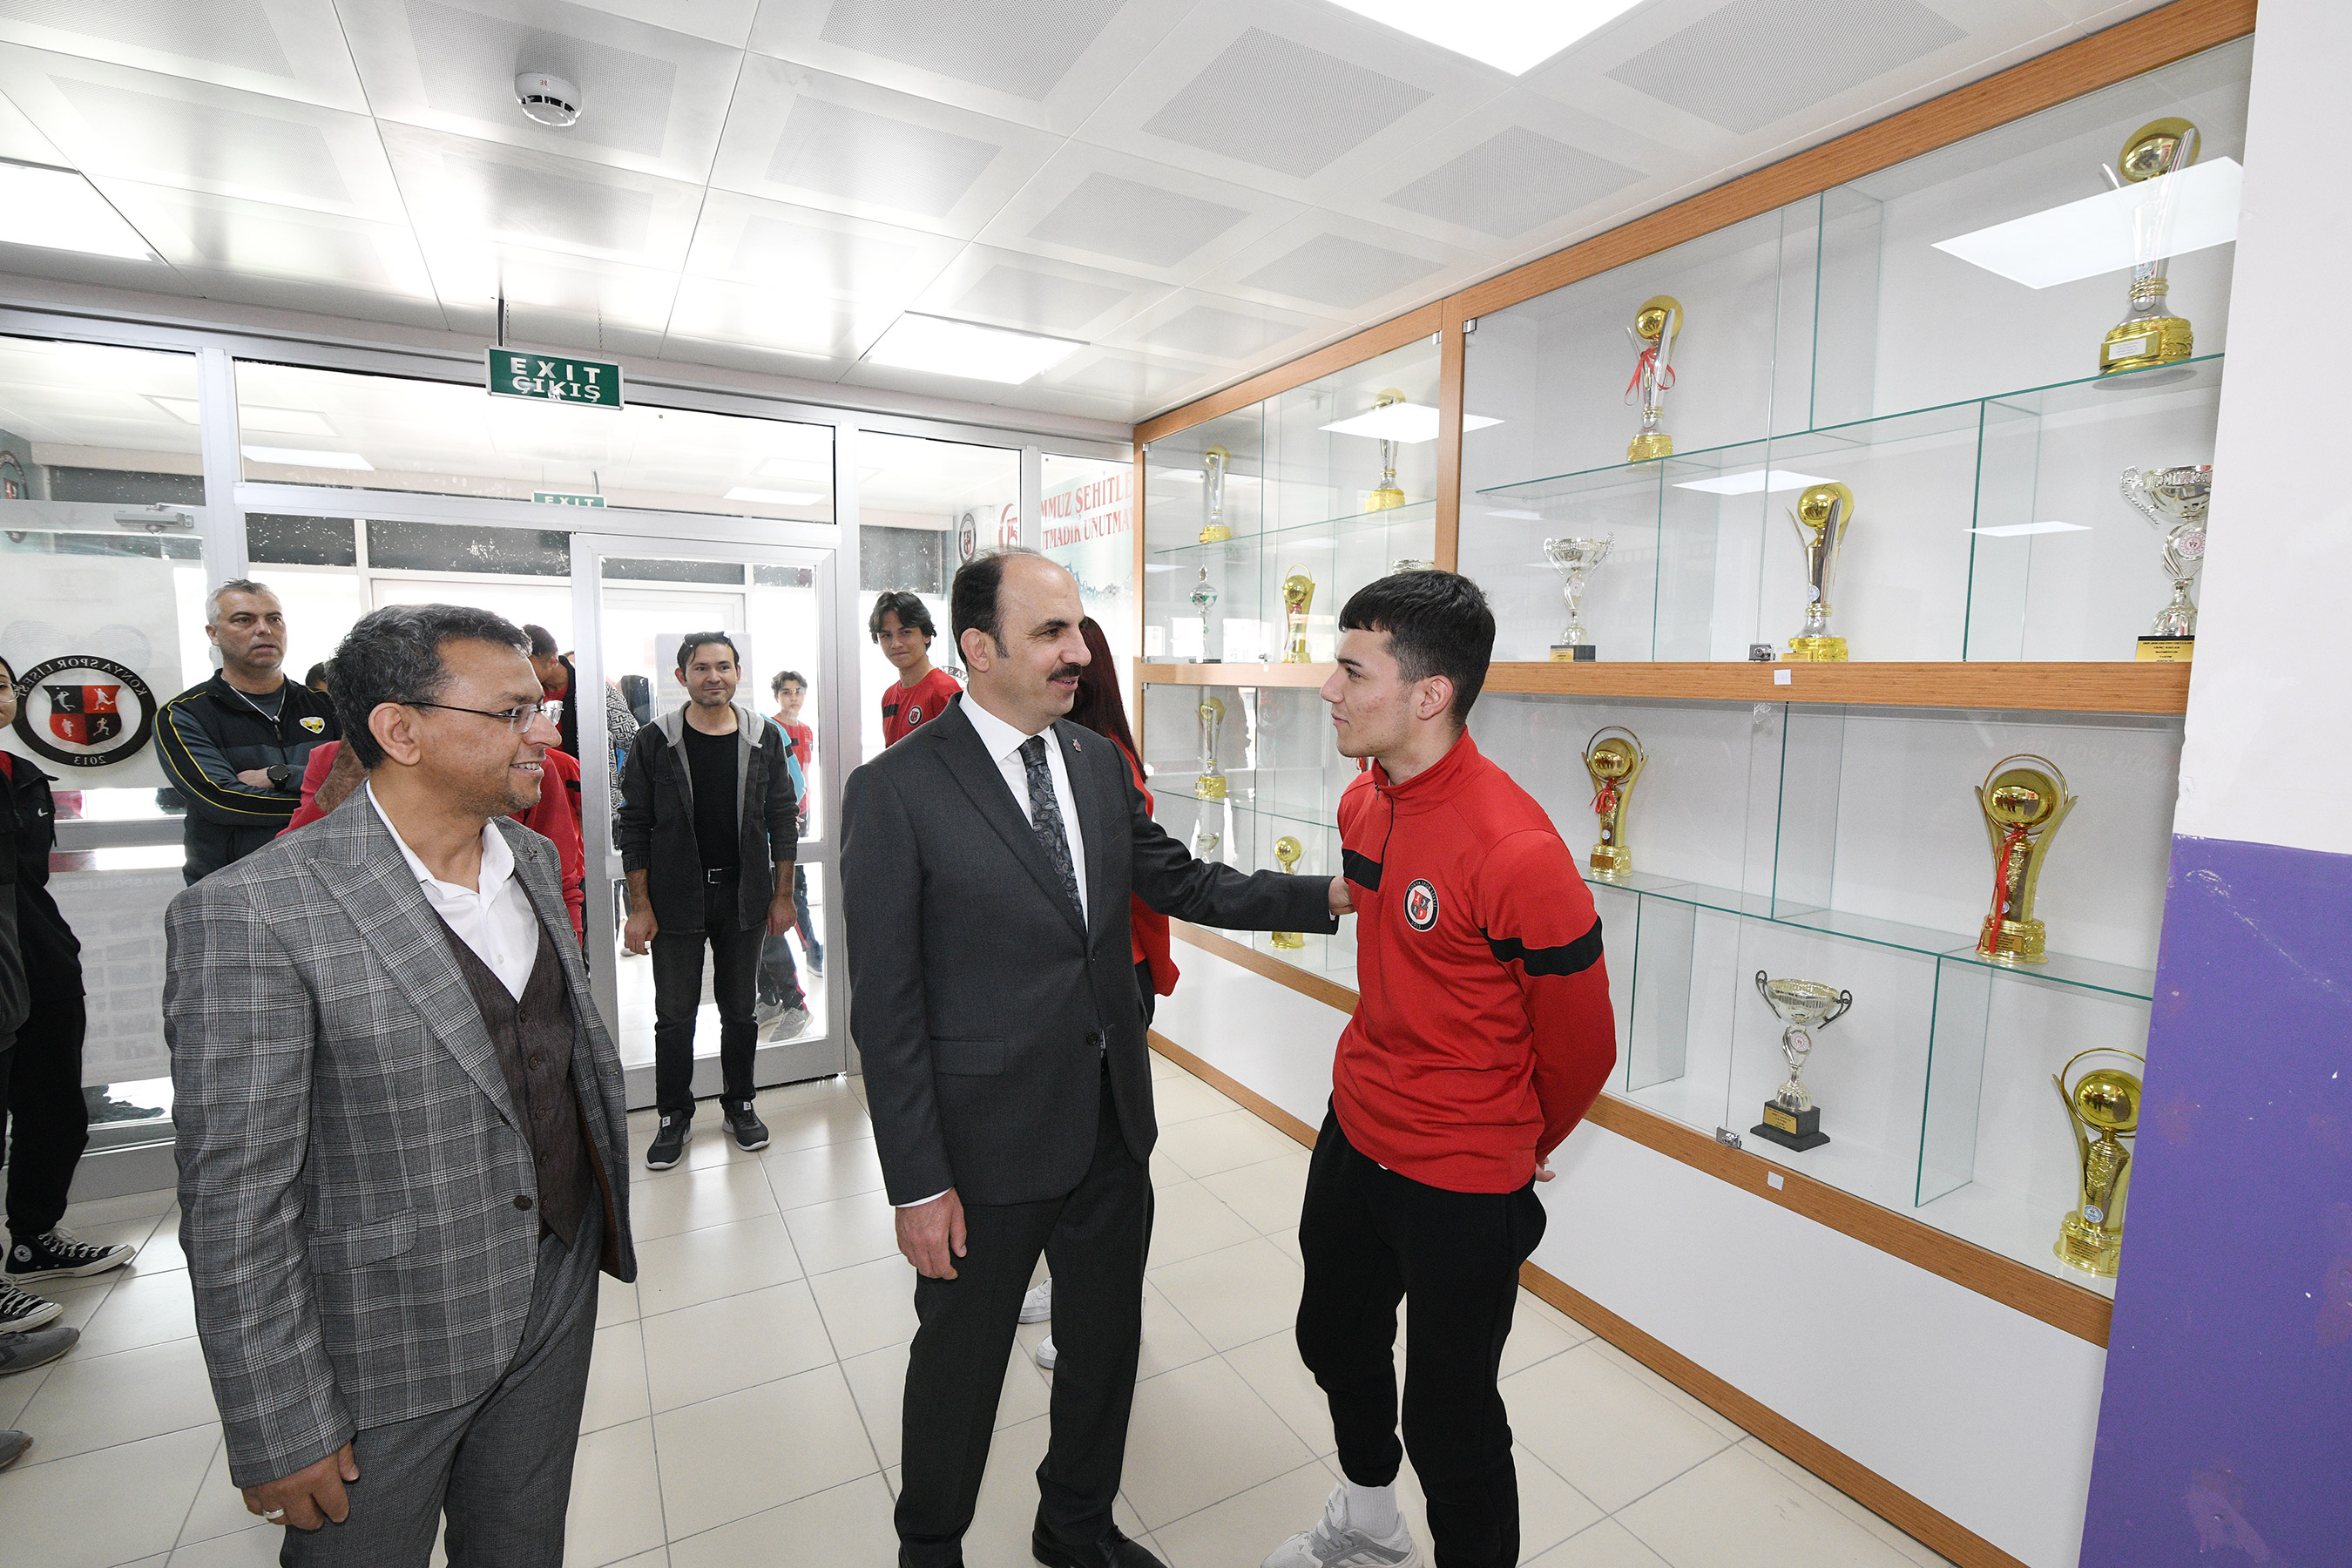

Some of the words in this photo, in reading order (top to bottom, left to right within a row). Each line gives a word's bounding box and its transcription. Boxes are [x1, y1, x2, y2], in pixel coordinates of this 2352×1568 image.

[510, 357, 601, 384] EXIT
[512, 376, 601, 402] ÇIKIŞ
[544, 496, 594, 507] EXIT
